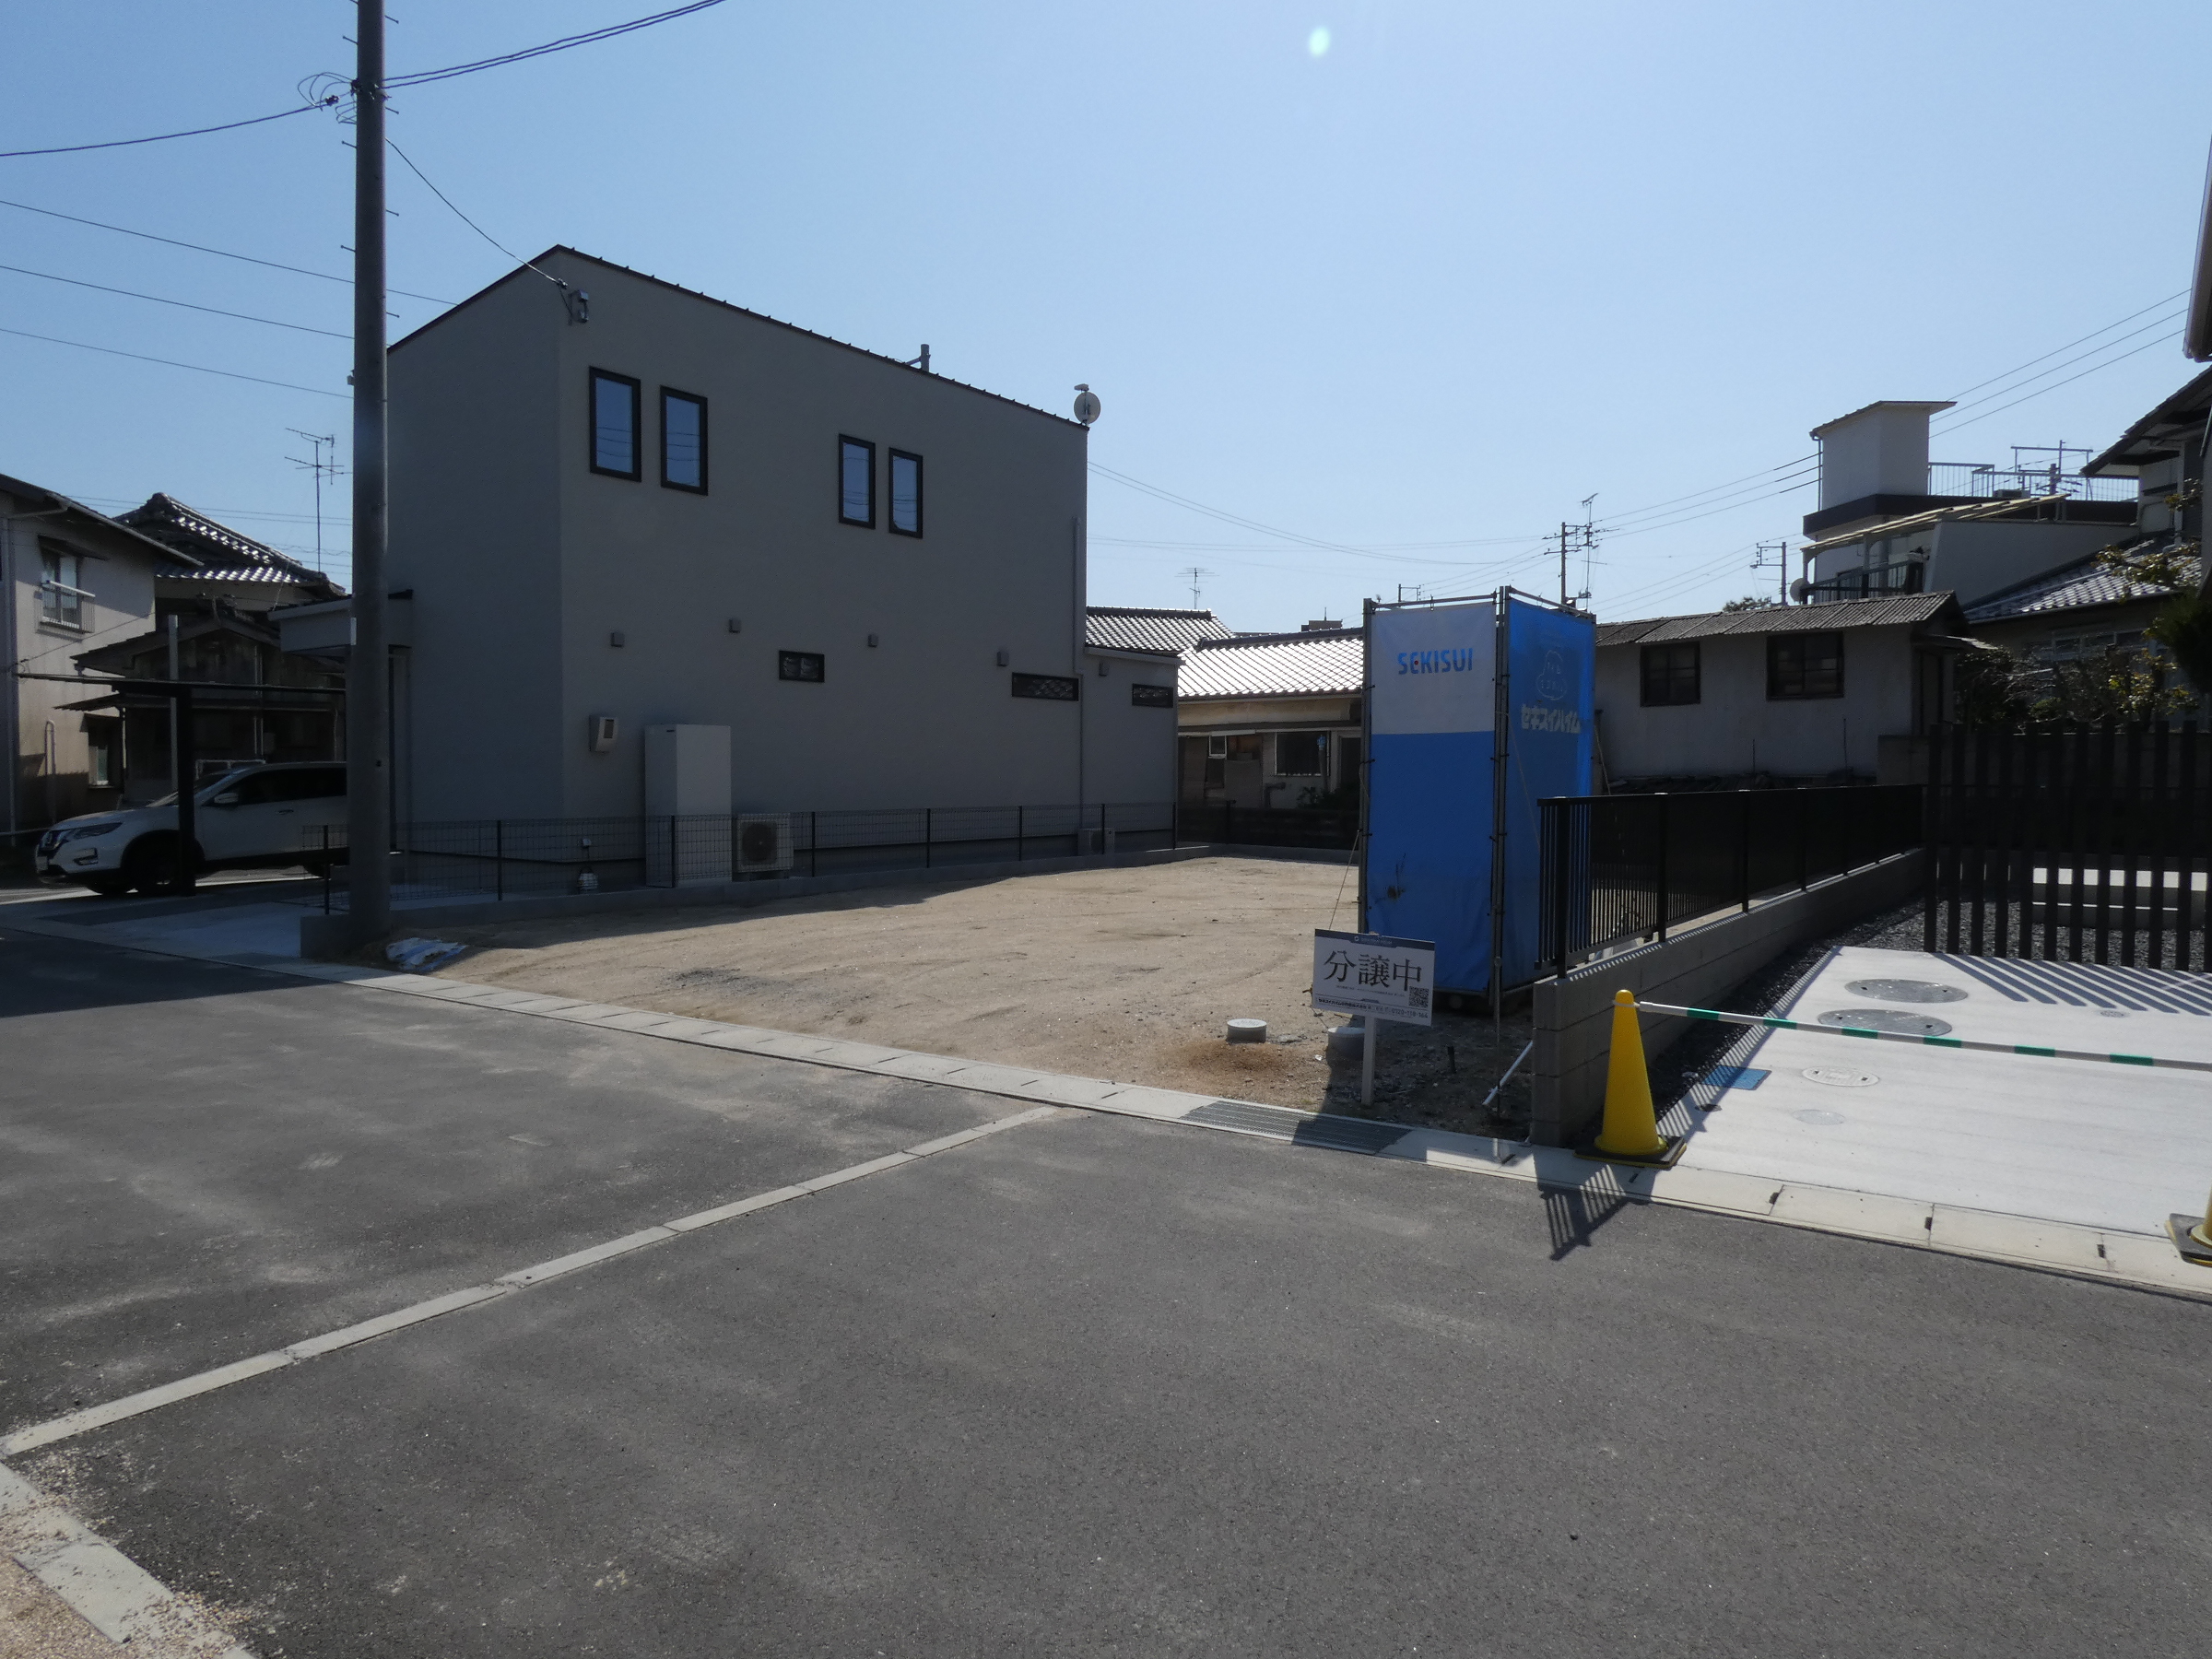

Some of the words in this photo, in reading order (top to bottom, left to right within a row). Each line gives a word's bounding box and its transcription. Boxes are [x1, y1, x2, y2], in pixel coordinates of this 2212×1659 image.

[1397, 647, 1474, 676] SEKISUI
[1521, 703, 1582, 735] セキスイハイム
[1323, 949, 1422, 992] 分譲中
